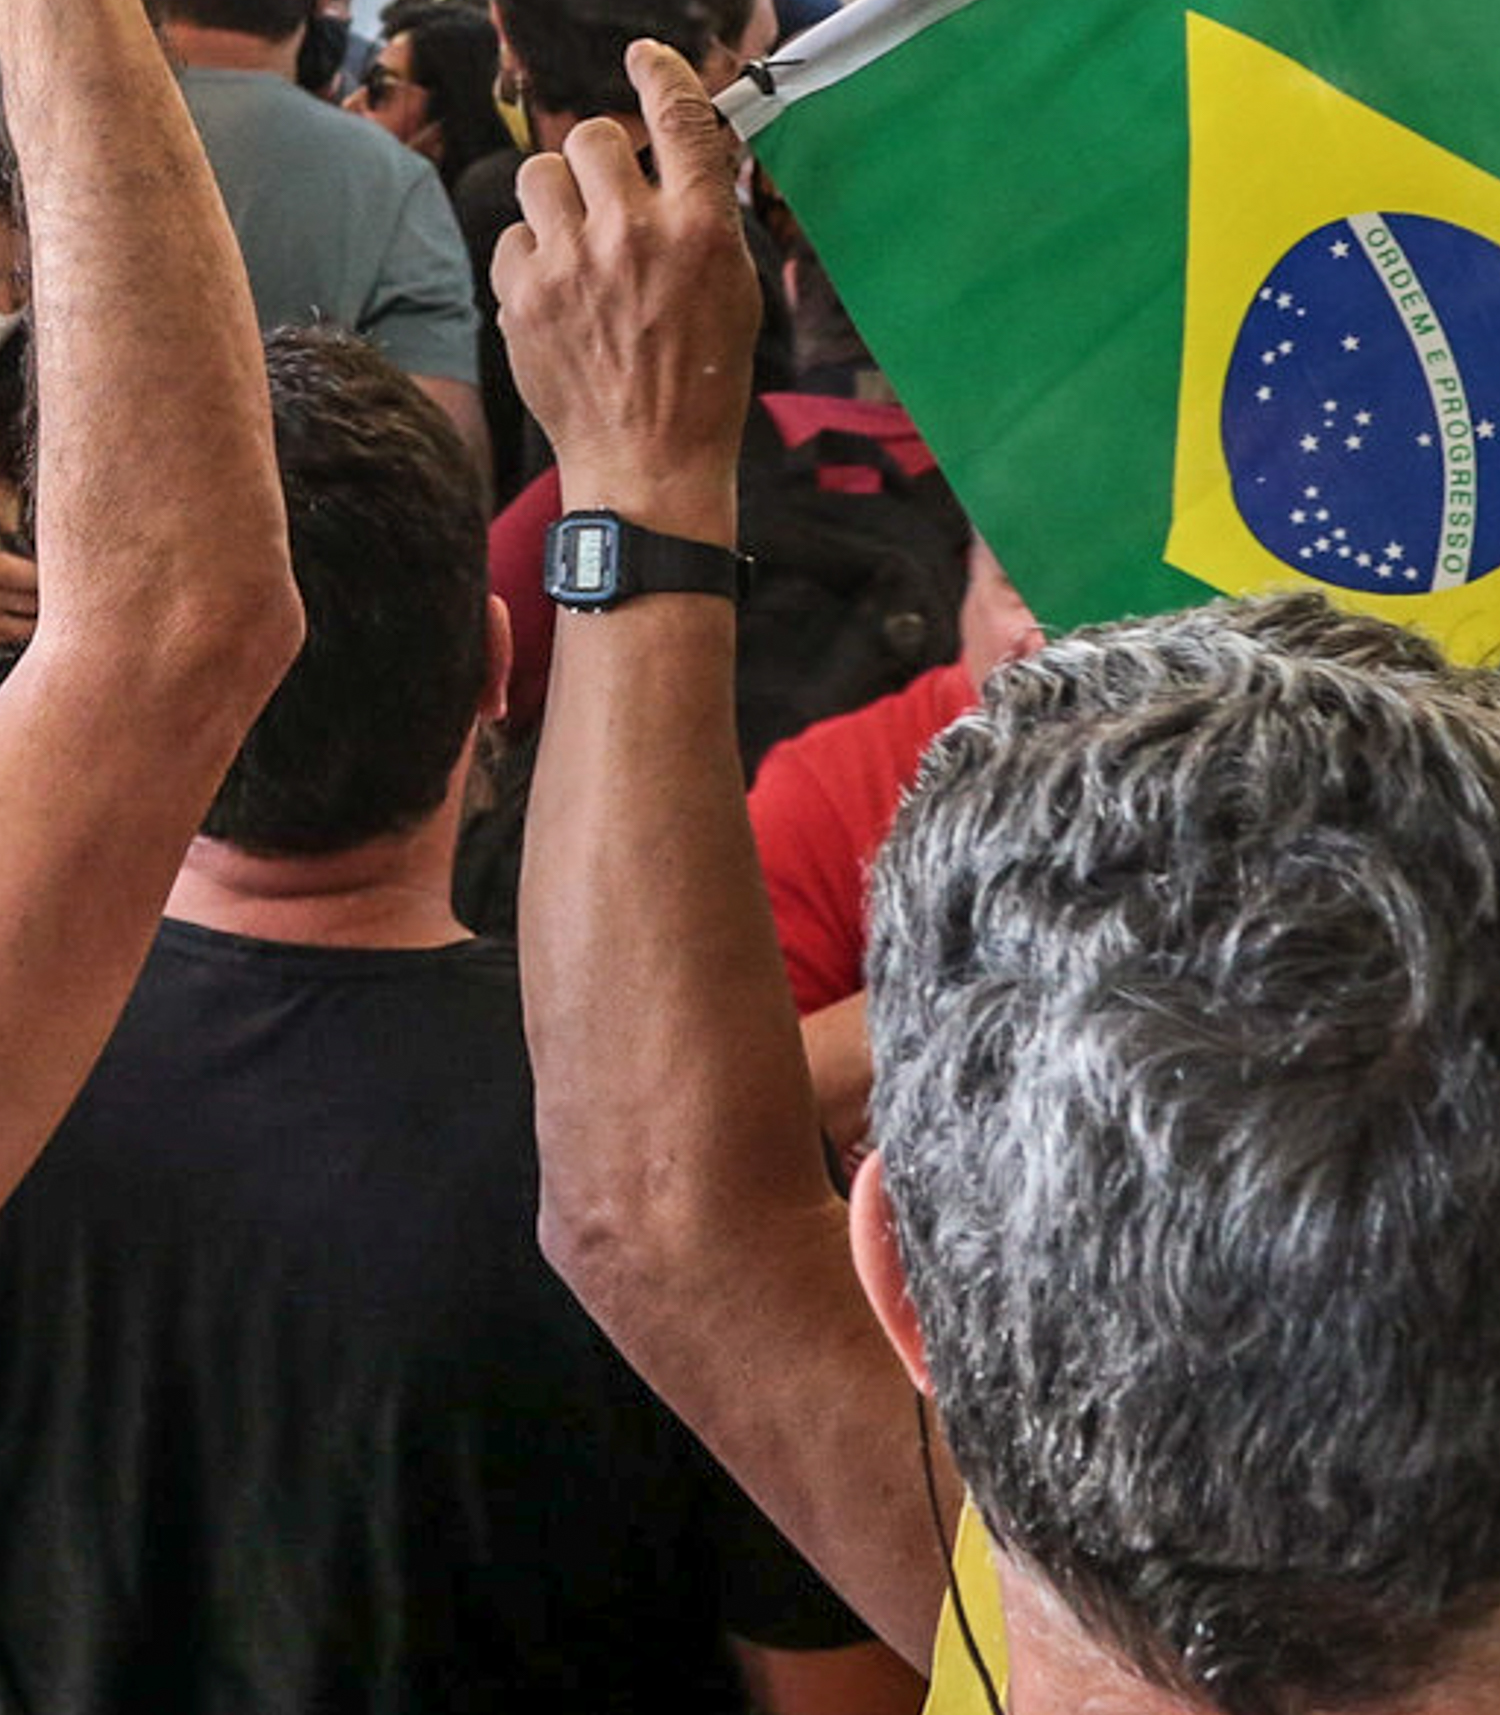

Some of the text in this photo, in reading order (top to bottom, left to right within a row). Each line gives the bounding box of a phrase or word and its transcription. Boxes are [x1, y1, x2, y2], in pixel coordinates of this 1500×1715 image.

[1365, 227, 1475, 574] ORDEM E PROGRESSO
